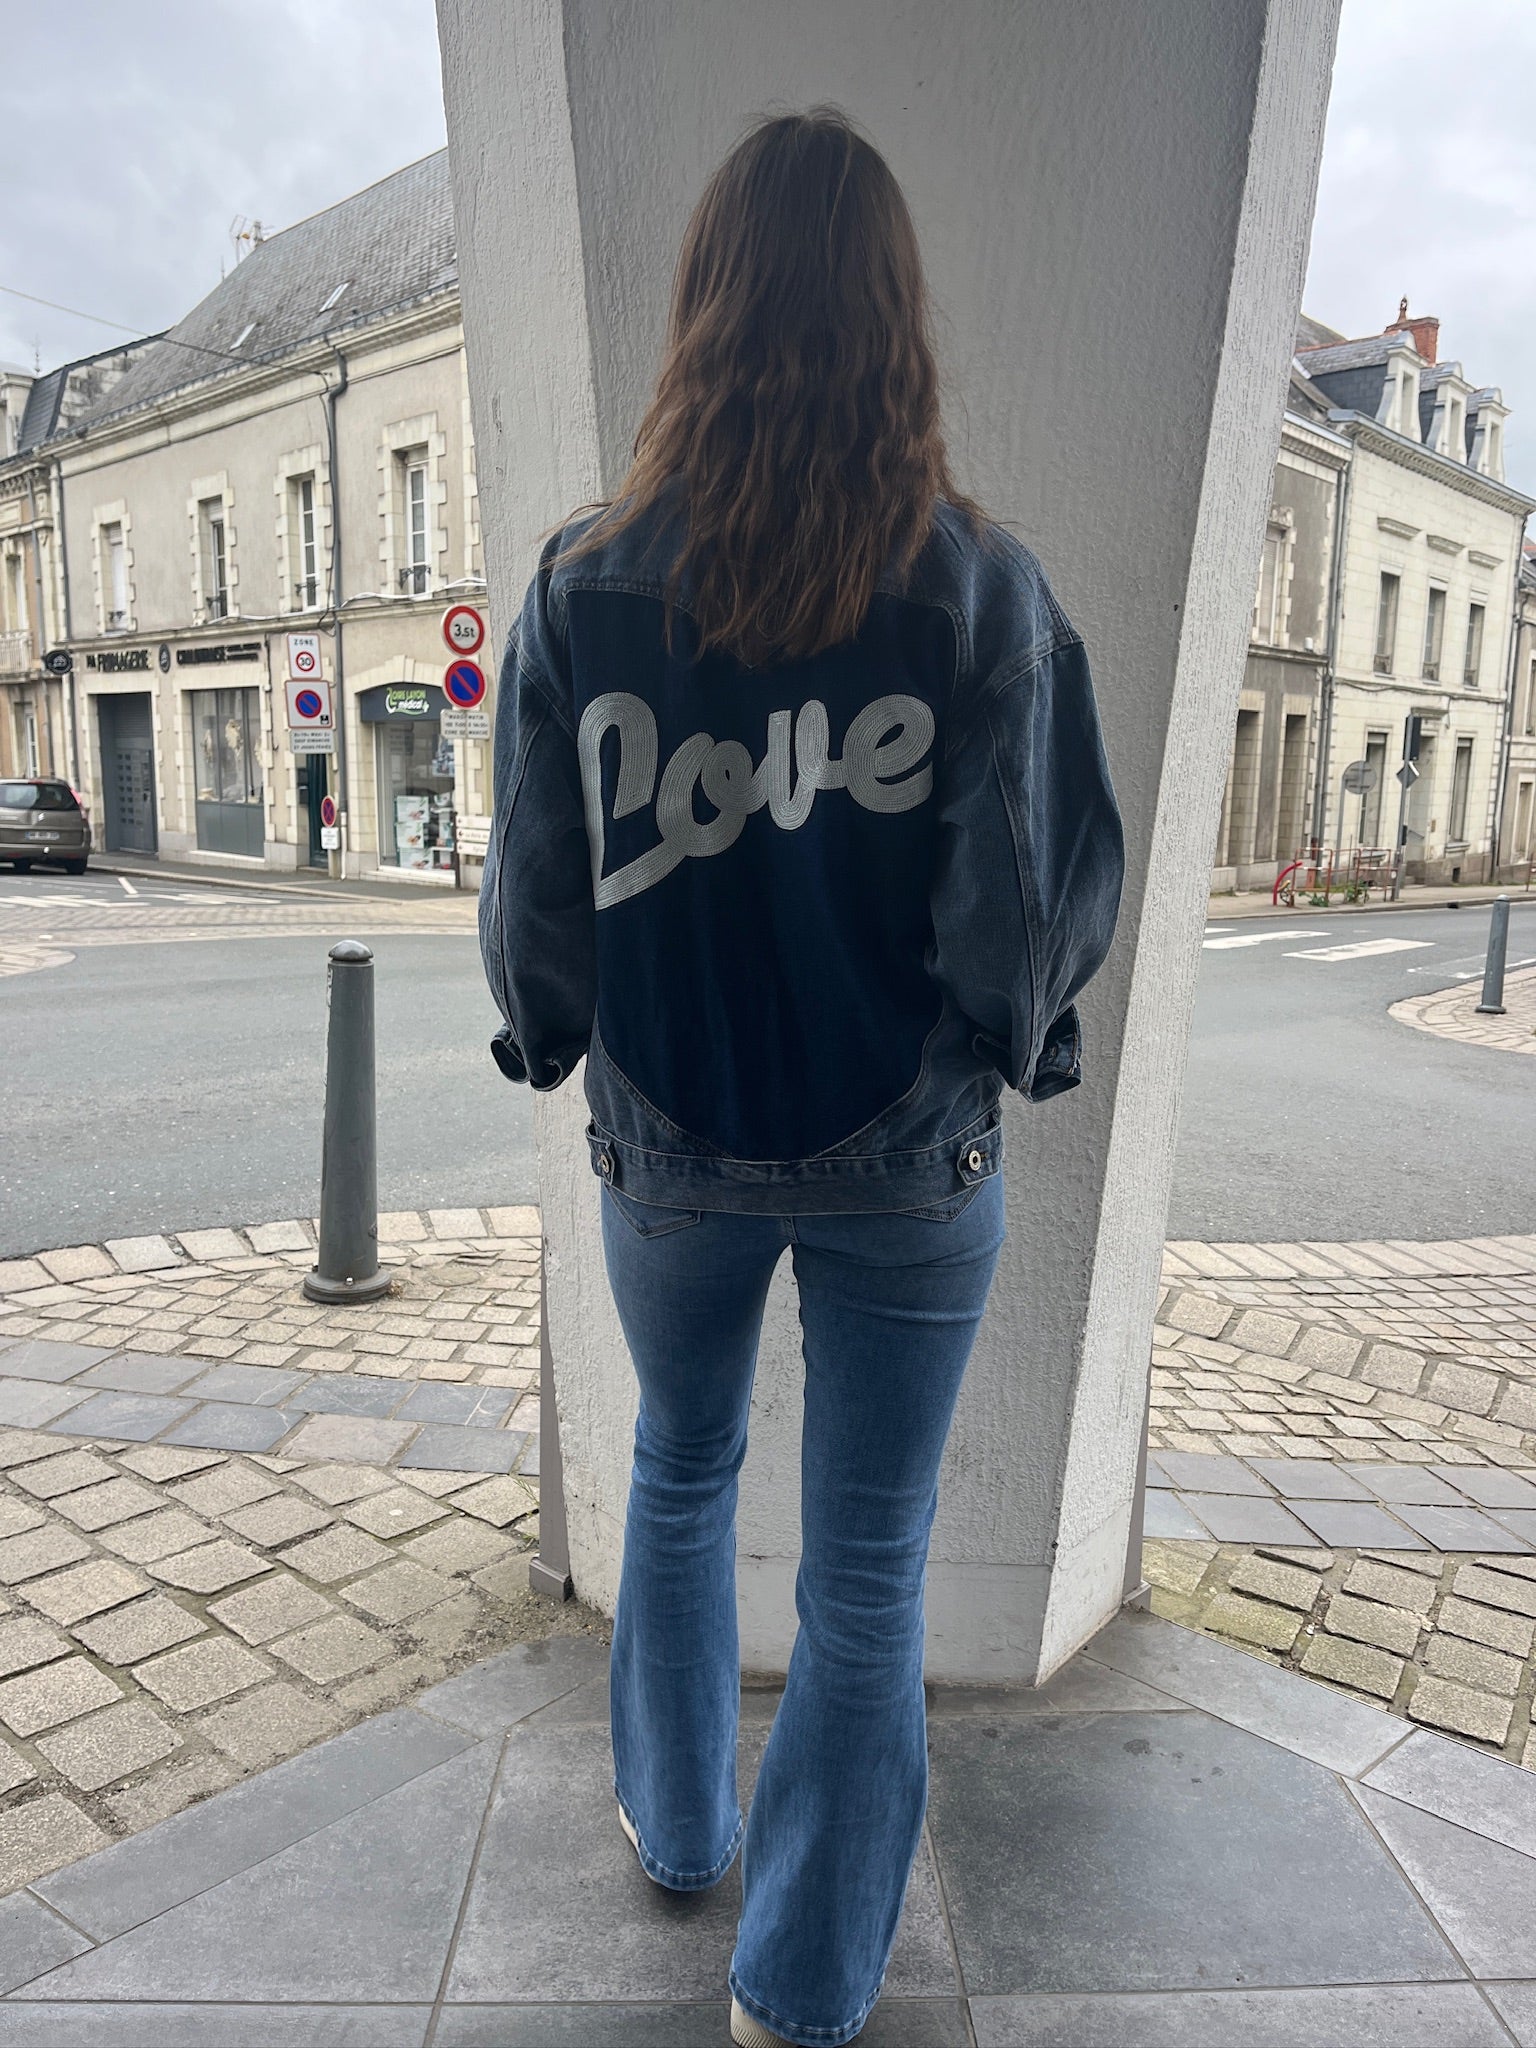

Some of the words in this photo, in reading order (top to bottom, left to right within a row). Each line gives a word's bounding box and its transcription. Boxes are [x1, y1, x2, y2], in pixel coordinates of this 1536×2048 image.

[454, 624, 476, 638] 3.5t
[294, 638, 313, 646] ZONE
[300, 657, 311, 667] 30
[577, 691, 936, 912] Love
